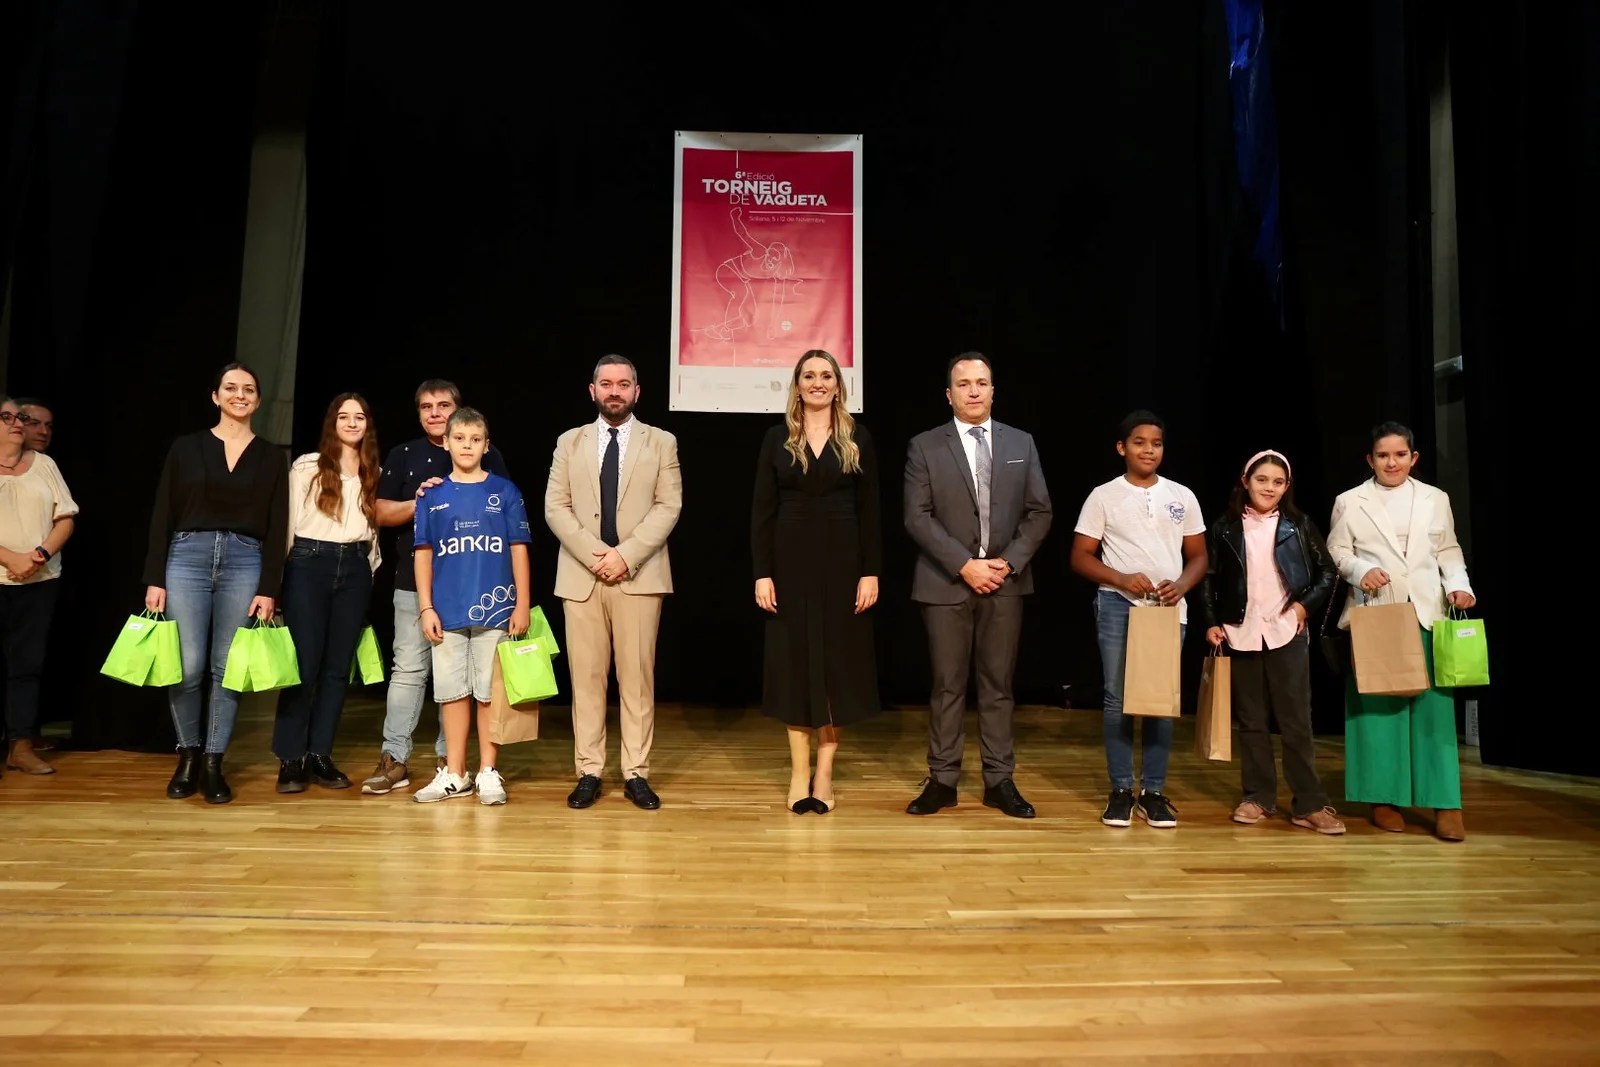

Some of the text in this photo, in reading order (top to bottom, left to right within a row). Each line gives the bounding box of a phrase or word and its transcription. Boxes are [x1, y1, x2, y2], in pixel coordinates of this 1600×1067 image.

[747, 172, 775, 181] Edició
[702, 179, 792, 194] TORNEIG
[730, 194, 828, 206] DE VAQUETA
